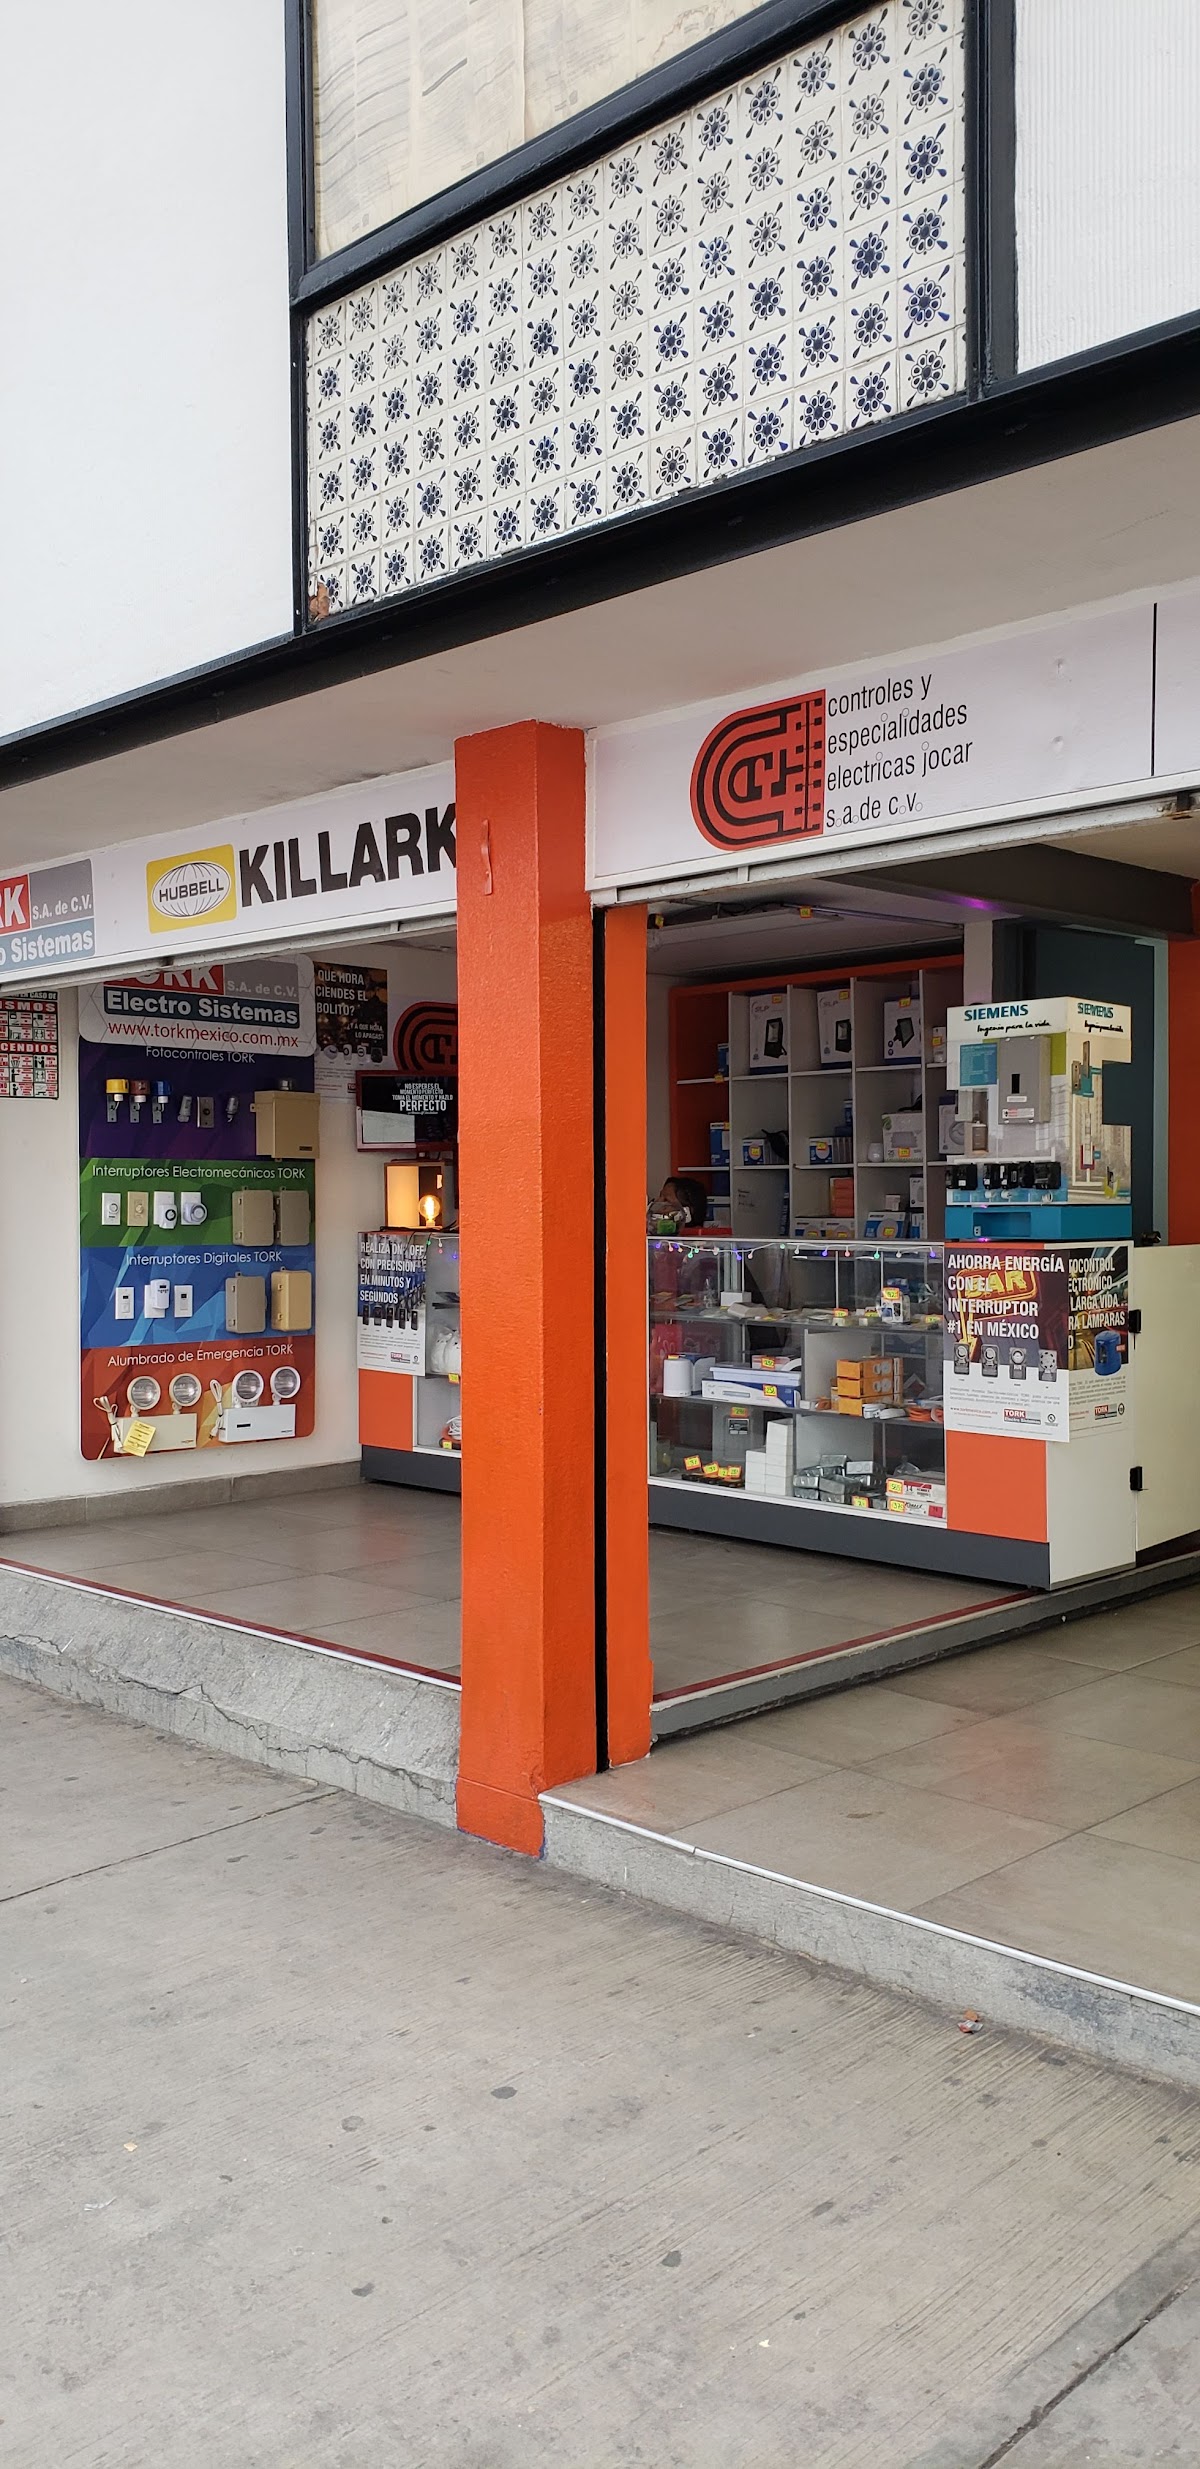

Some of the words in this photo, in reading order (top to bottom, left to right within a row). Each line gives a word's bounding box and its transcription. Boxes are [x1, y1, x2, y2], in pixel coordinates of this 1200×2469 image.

[828, 677, 914, 717] controles
[920, 673, 932, 701] y
[828, 703, 968, 755] especialidades
[827, 752, 916, 792] electricas
[922, 741, 973, 777] jocar
[860, 796, 881, 821] de
[239, 802, 457, 908] KILLARK
[159, 878, 224, 903] HUBBELL
[32, 904, 53, 920] S.A.
[55, 900, 68, 914] de
[70, 894, 92, 913] C.V.
[11, 930, 94, 963] Sistemas
[317, 969, 337, 983] QUE
[339, 972, 365, 986] HORA
[227, 980, 252, 993] S.A.
[255, 983, 271, 996] de
[274, 985, 298, 998] C.V.
[315, 985, 355, 1001] CIENDES
[357, 990, 369, 1002] EL
[106, 990, 192, 1016] Electro
[198, 998, 299, 1025] Sistemas
[316, 1002, 355, 1017] BOLITO?
[964, 1004, 1029, 1022] SIEMENS
[108, 1022, 299, 1048] www.torkmexico.com.mx
[976, 1023, 1005, 1036] Ingenio
[1004, 1022, 1024, 1033] para
[1024, 1021, 1033, 1029] la
[1034, 1019, 1052, 1028] vida
[146, 1046, 224, 1062] Fotocontroles
[227, 1052, 256, 1063] TORK
[399, 1100, 447, 1111] PERFECTO
[92, 1164, 169, 1182] Interruptores
[173, 1165, 275, 1179] Electromecánicos
[277, 1167, 306, 1179] TORK
[360, 1241, 390, 1255] REALIZA
[126, 1252, 201, 1270] Interruptores
[204, 1251, 251, 1267] Digitales
[254, 1250, 282, 1263] TORK
[360, 1257, 375, 1270] CON
[947, 1254, 1001, 1271] AHORRA
[1005, 1253, 1065, 1273] ENERGÍA
[360, 1273, 370, 1285] EN
[371, 1274, 404, 1288] MINUTOS
[404, 1277, 412, 1289] Y
[948, 1275, 978, 1291] CON
[979, 1277, 993, 1292] EL
[360, 1289, 399, 1304] SEGUNDOS
[1070, 1295, 1098, 1312] LARGA
[948, 1297, 1039, 1317] INTERRUPTOR
[1082, 1311, 1126, 1329] LÁMPARAS
[947, 1319, 961, 1335] #1
[967, 1320, 983, 1336] EN
[987, 1320, 1039, 1340] MÉXICO
[107, 1351, 175, 1368] Alumbrado
[178, 1350, 194, 1362] de
[196, 1345, 264, 1365] Emergencia
[265, 1343, 294, 1356] TORK
[1004, 1409, 1026, 1418] TORK
